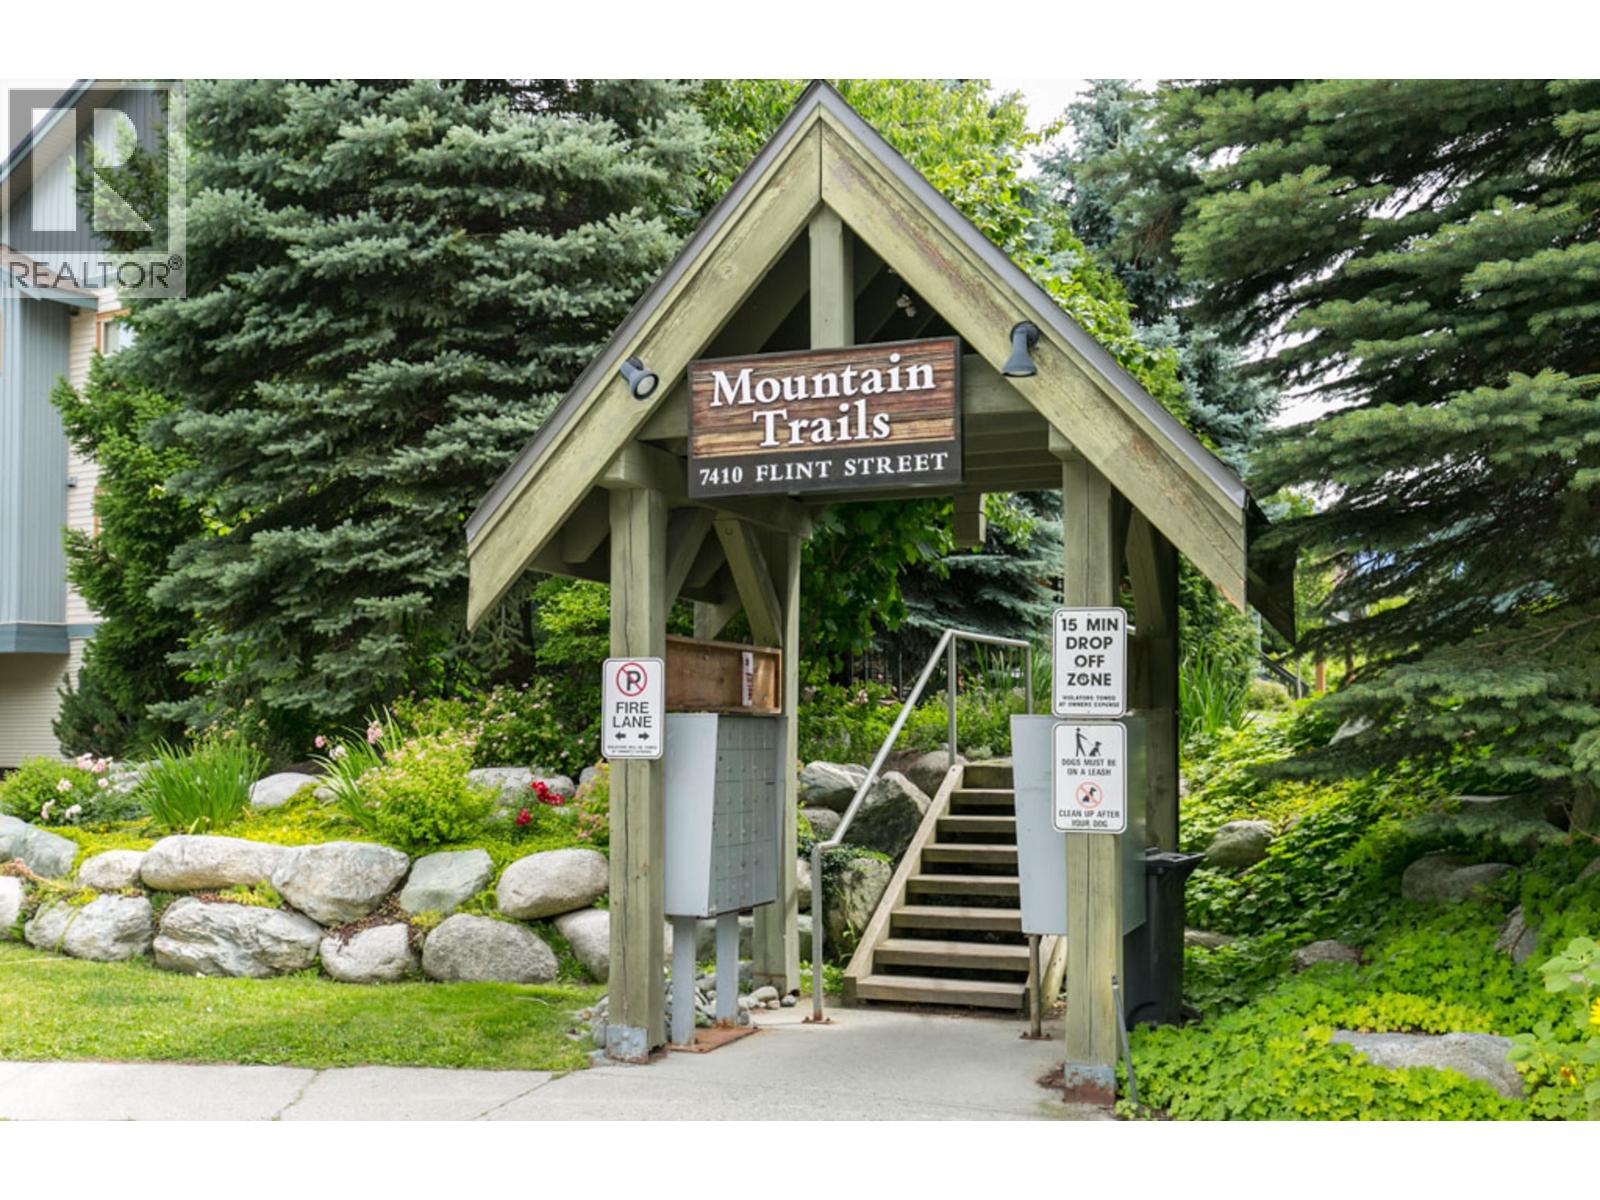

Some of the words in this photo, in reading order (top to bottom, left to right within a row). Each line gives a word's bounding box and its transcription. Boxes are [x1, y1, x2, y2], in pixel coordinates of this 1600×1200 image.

[709, 352, 936, 407] Mountain
[752, 399, 891, 447] Trails
[699, 465, 743, 486] 7410
[755, 460, 832, 482] FLINT
[844, 452, 948, 477] STREET
[1061, 618, 1077, 632] 15
[1086, 618, 1119, 632] MIN
[1066, 636, 1113, 650] DROP
[1074, 655, 1105, 668] OFF
[1067, 672, 1112, 686] ZONE
[616, 701, 649, 714] FIRE
[612, 716, 652, 728] LANE
[1062, 758, 1081, 766] DOGS
[1084, 759, 1105, 767] MUST
[1107, 759, 1117, 767] BE
[1066, 768, 1078, 776] ON
[1080, 768, 1086, 776] A
[1088, 768, 1112, 776] LEASH
[1058, 809, 1082, 817] CLEAN
[1084, 809, 1095, 817] UP
[1097, 810, 1120, 818] AFTER
[1072, 820, 1090, 828] YOUR
[1093, 820, 1108, 828] DOG
